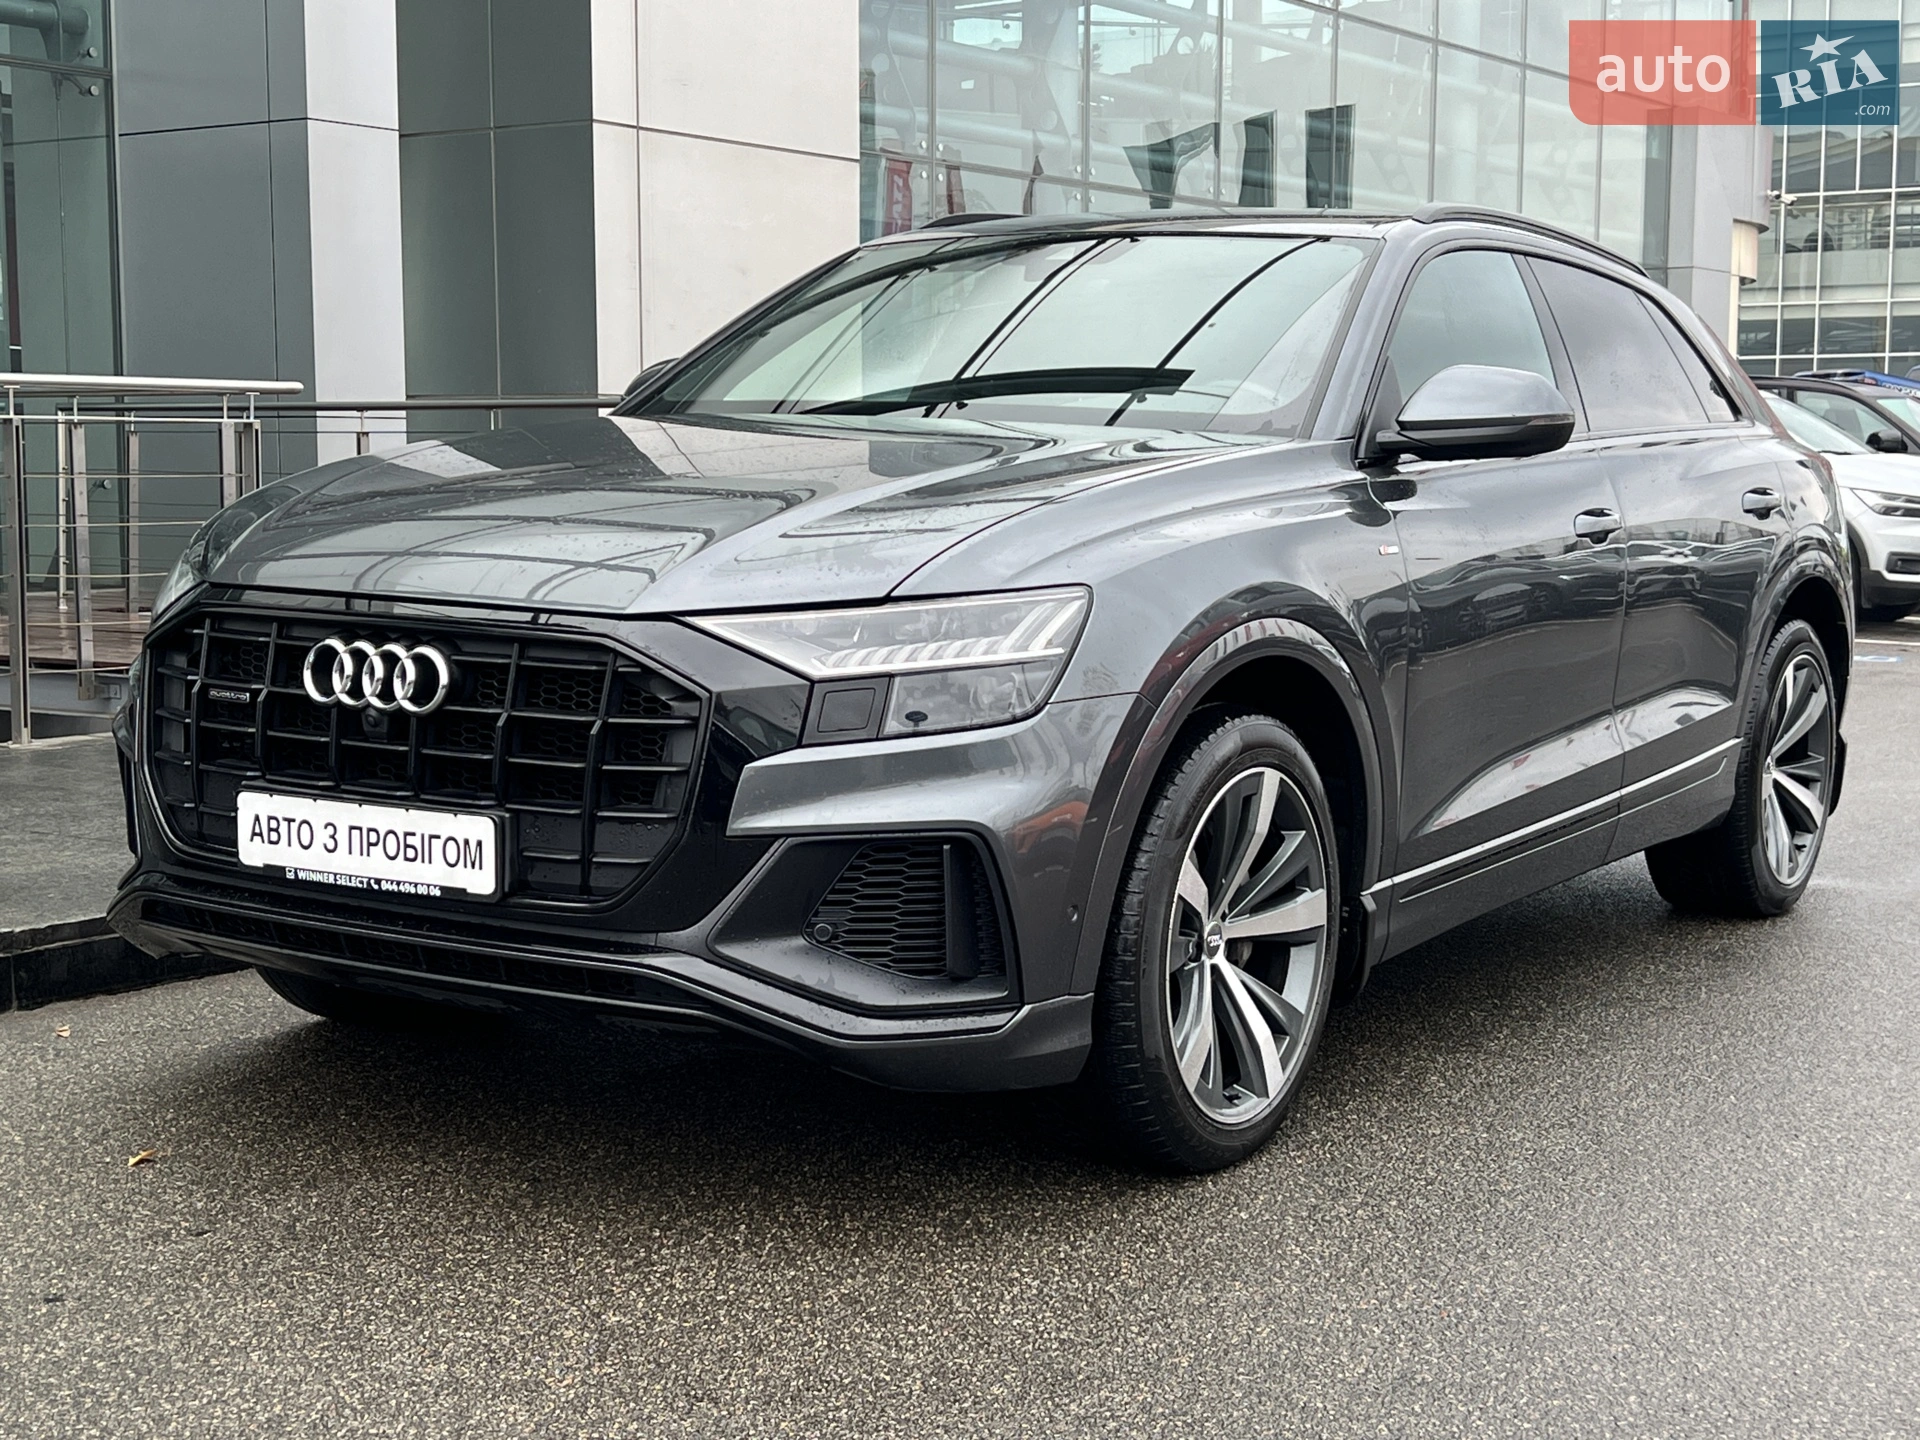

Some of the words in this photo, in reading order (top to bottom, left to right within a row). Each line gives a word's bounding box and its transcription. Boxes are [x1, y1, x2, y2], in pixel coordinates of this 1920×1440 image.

[250, 813, 314, 850] АВТО
[323, 822, 338, 853] З
[348, 825, 483, 870] ПРОБІГОМ
[297, 869, 335, 885] WINNER
[336, 874, 369, 888] SELECT
[381, 880, 398, 892] 044
[399, 882, 416, 894] 496
[417, 884, 428, 895] 00
[429, 885, 441, 896] 06
